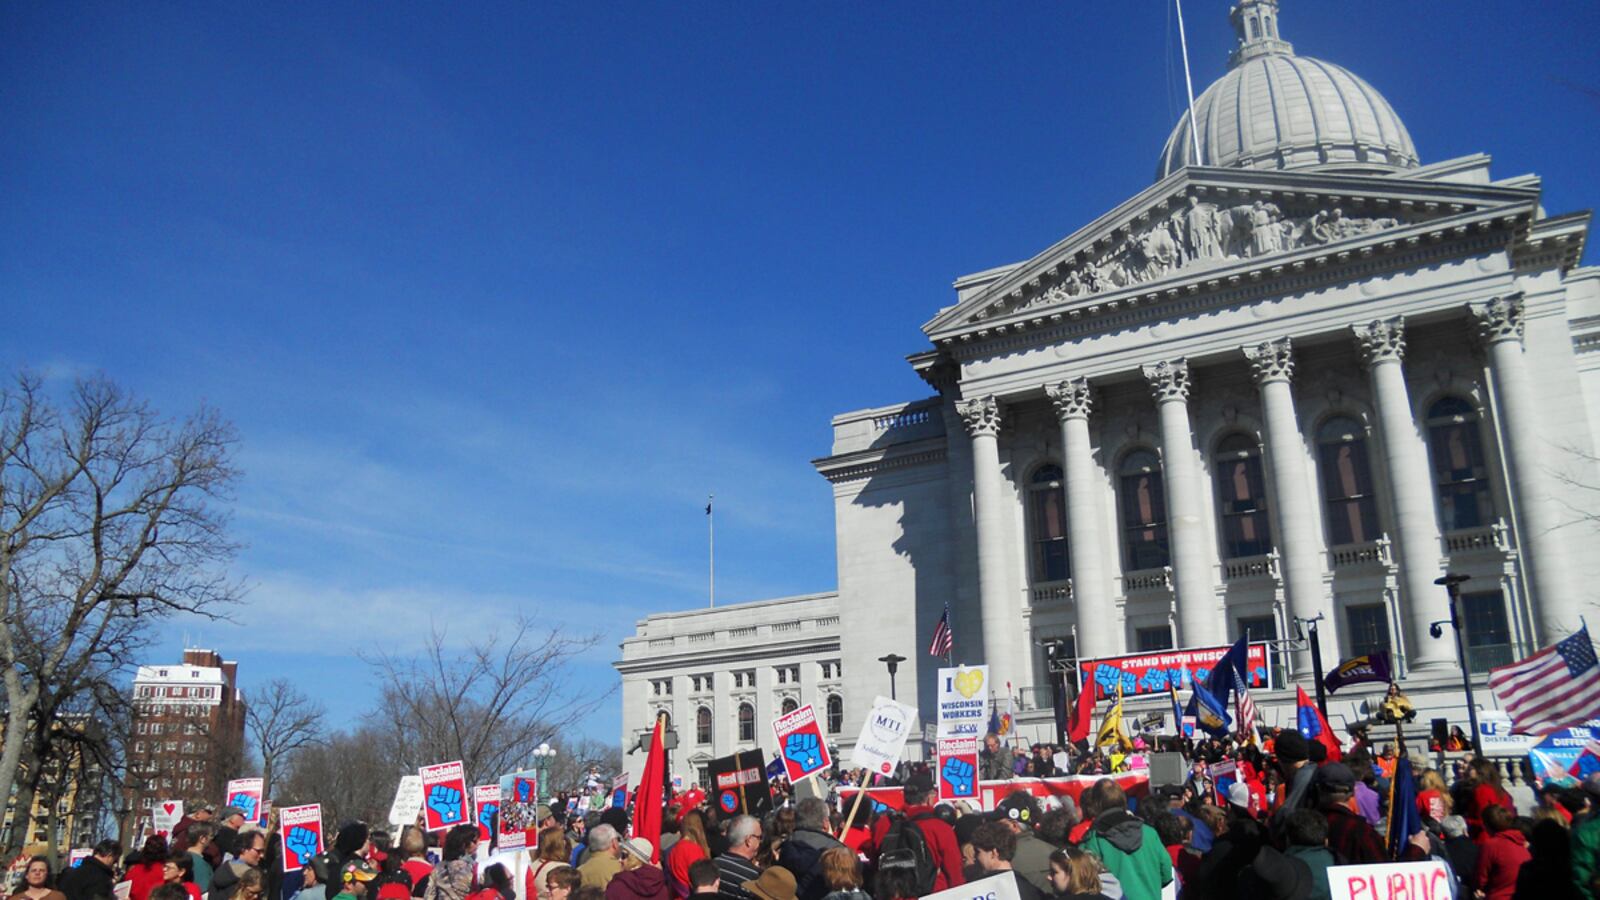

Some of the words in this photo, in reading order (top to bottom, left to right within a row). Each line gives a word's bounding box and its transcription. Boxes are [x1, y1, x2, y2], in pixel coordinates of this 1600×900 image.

[1121, 657, 1159, 669] STAND
[1160, 653, 1191, 665] WITH
[1192, 648, 1261, 662] WISCIN
[946, 677, 952, 692] I
[941, 700, 983, 710] WISCONSIN
[774, 708, 813, 732] Reclaim
[943, 709, 982, 719] WORKERS
[876, 715, 901, 731] MTI
[940, 740, 976, 750] Reclaim
[423, 764, 461, 779] Reclaim
[283, 807, 319, 820] Reclaim
